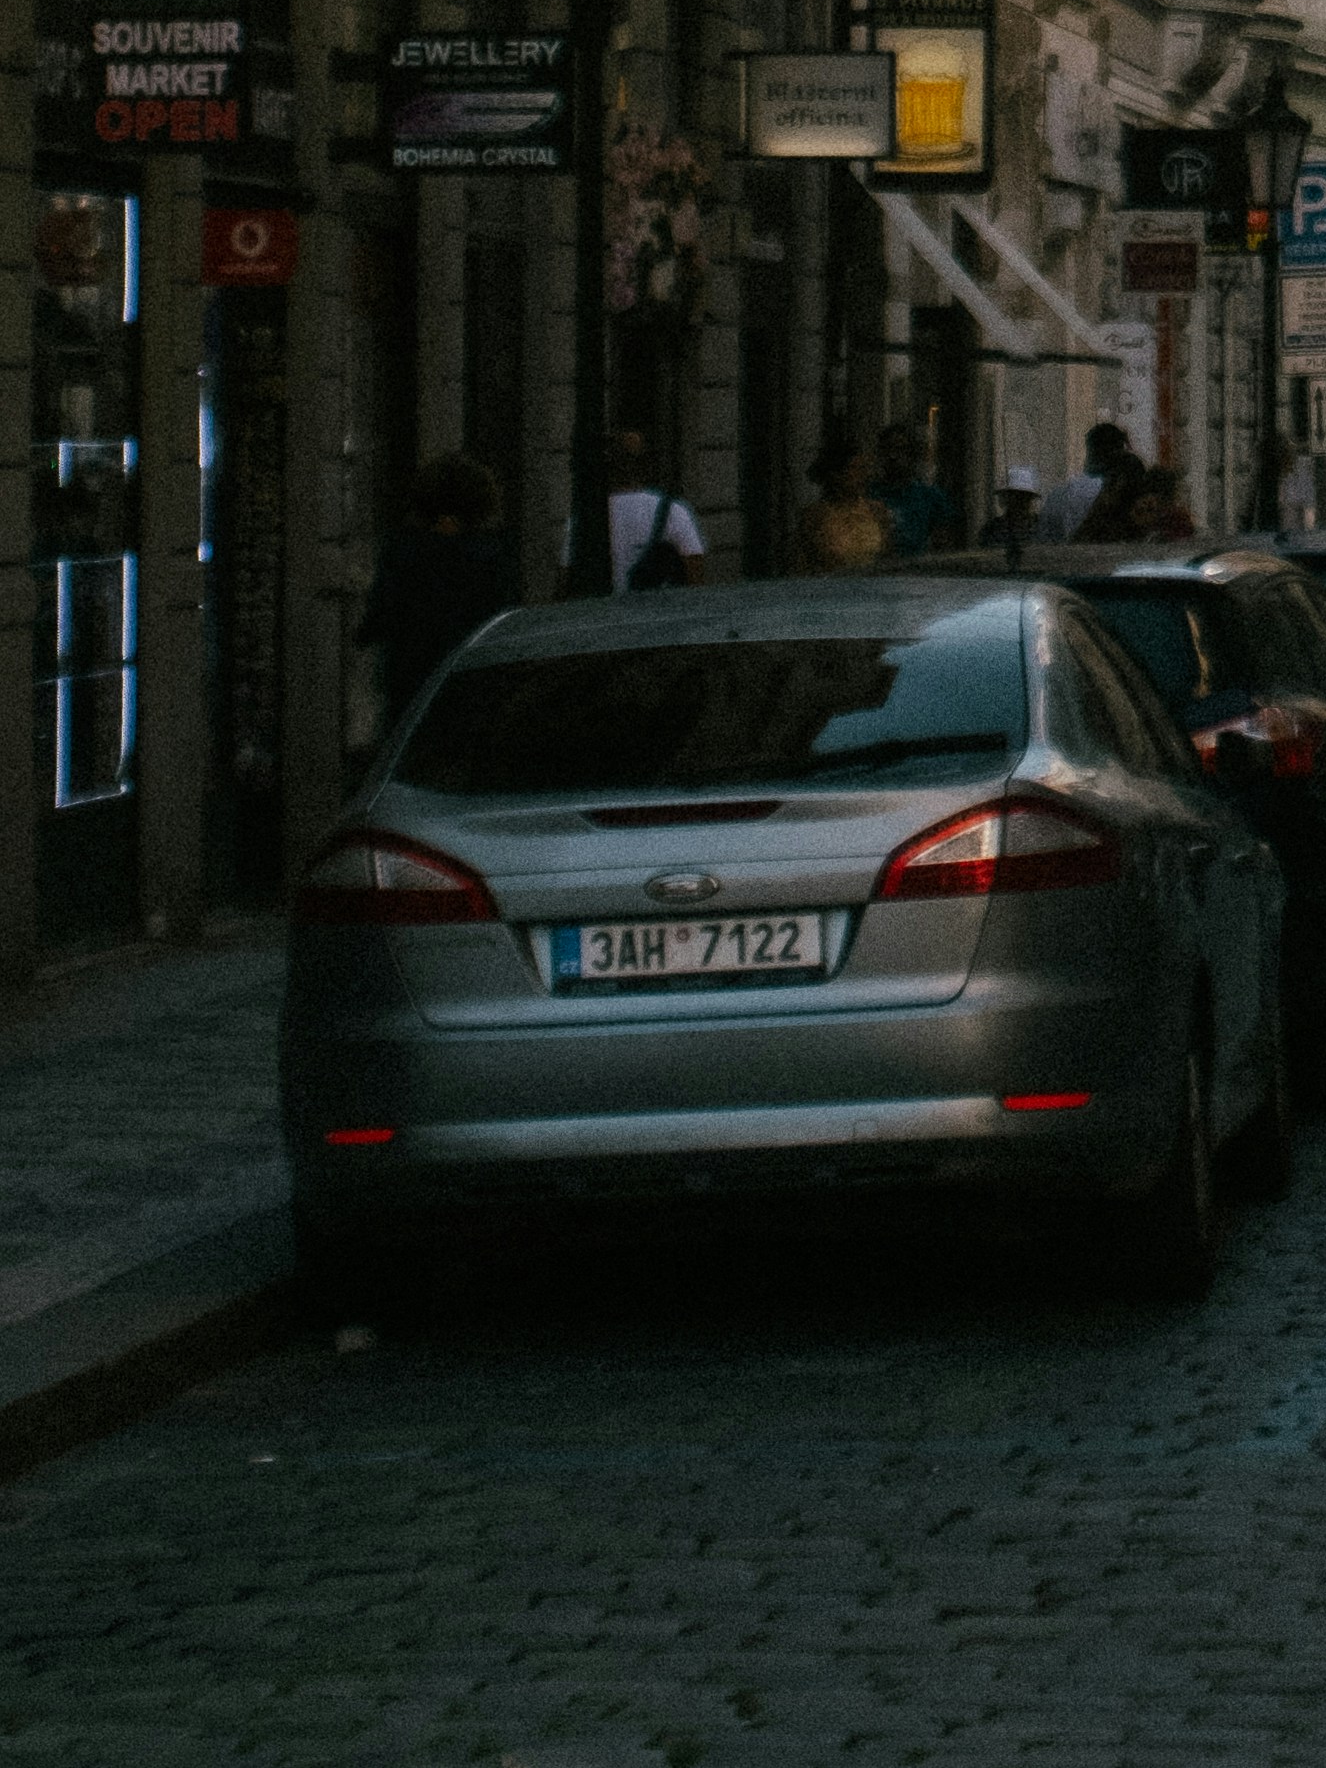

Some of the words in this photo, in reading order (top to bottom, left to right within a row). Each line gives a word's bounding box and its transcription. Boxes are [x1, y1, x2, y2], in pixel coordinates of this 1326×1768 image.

[92, 20, 243, 55] SOUVENIR
[391, 40, 562, 67] JEWELLERY
[106, 63, 229, 97] MARKET
[95, 99, 240, 143] OPEN
[393, 146, 477, 167] BOHEMIA
[482, 146, 558, 167] CRYSTAL
[591, 927, 666, 971] 3AH
[701, 921, 801, 966] 7122
